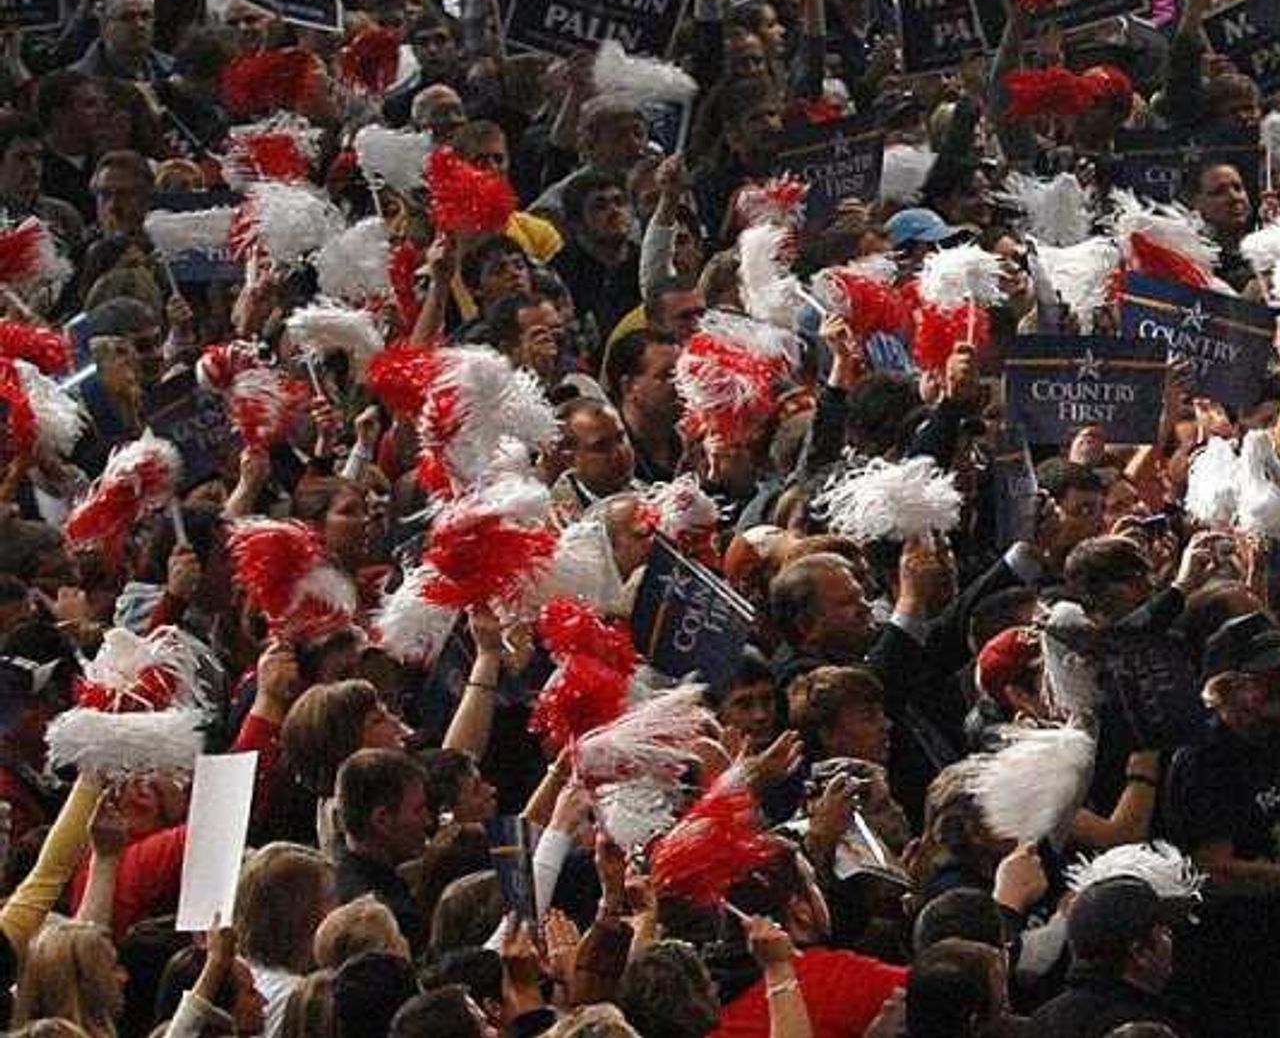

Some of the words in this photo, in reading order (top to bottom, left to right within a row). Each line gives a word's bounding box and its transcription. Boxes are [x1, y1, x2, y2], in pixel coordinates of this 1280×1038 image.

[543, 3, 644, 52] PALIN
[1138, 318, 1249, 362] COUNTRY
[1030, 379, 1136, 404] COUNTRY
[1057, 403, 1116, 424] FIRST
